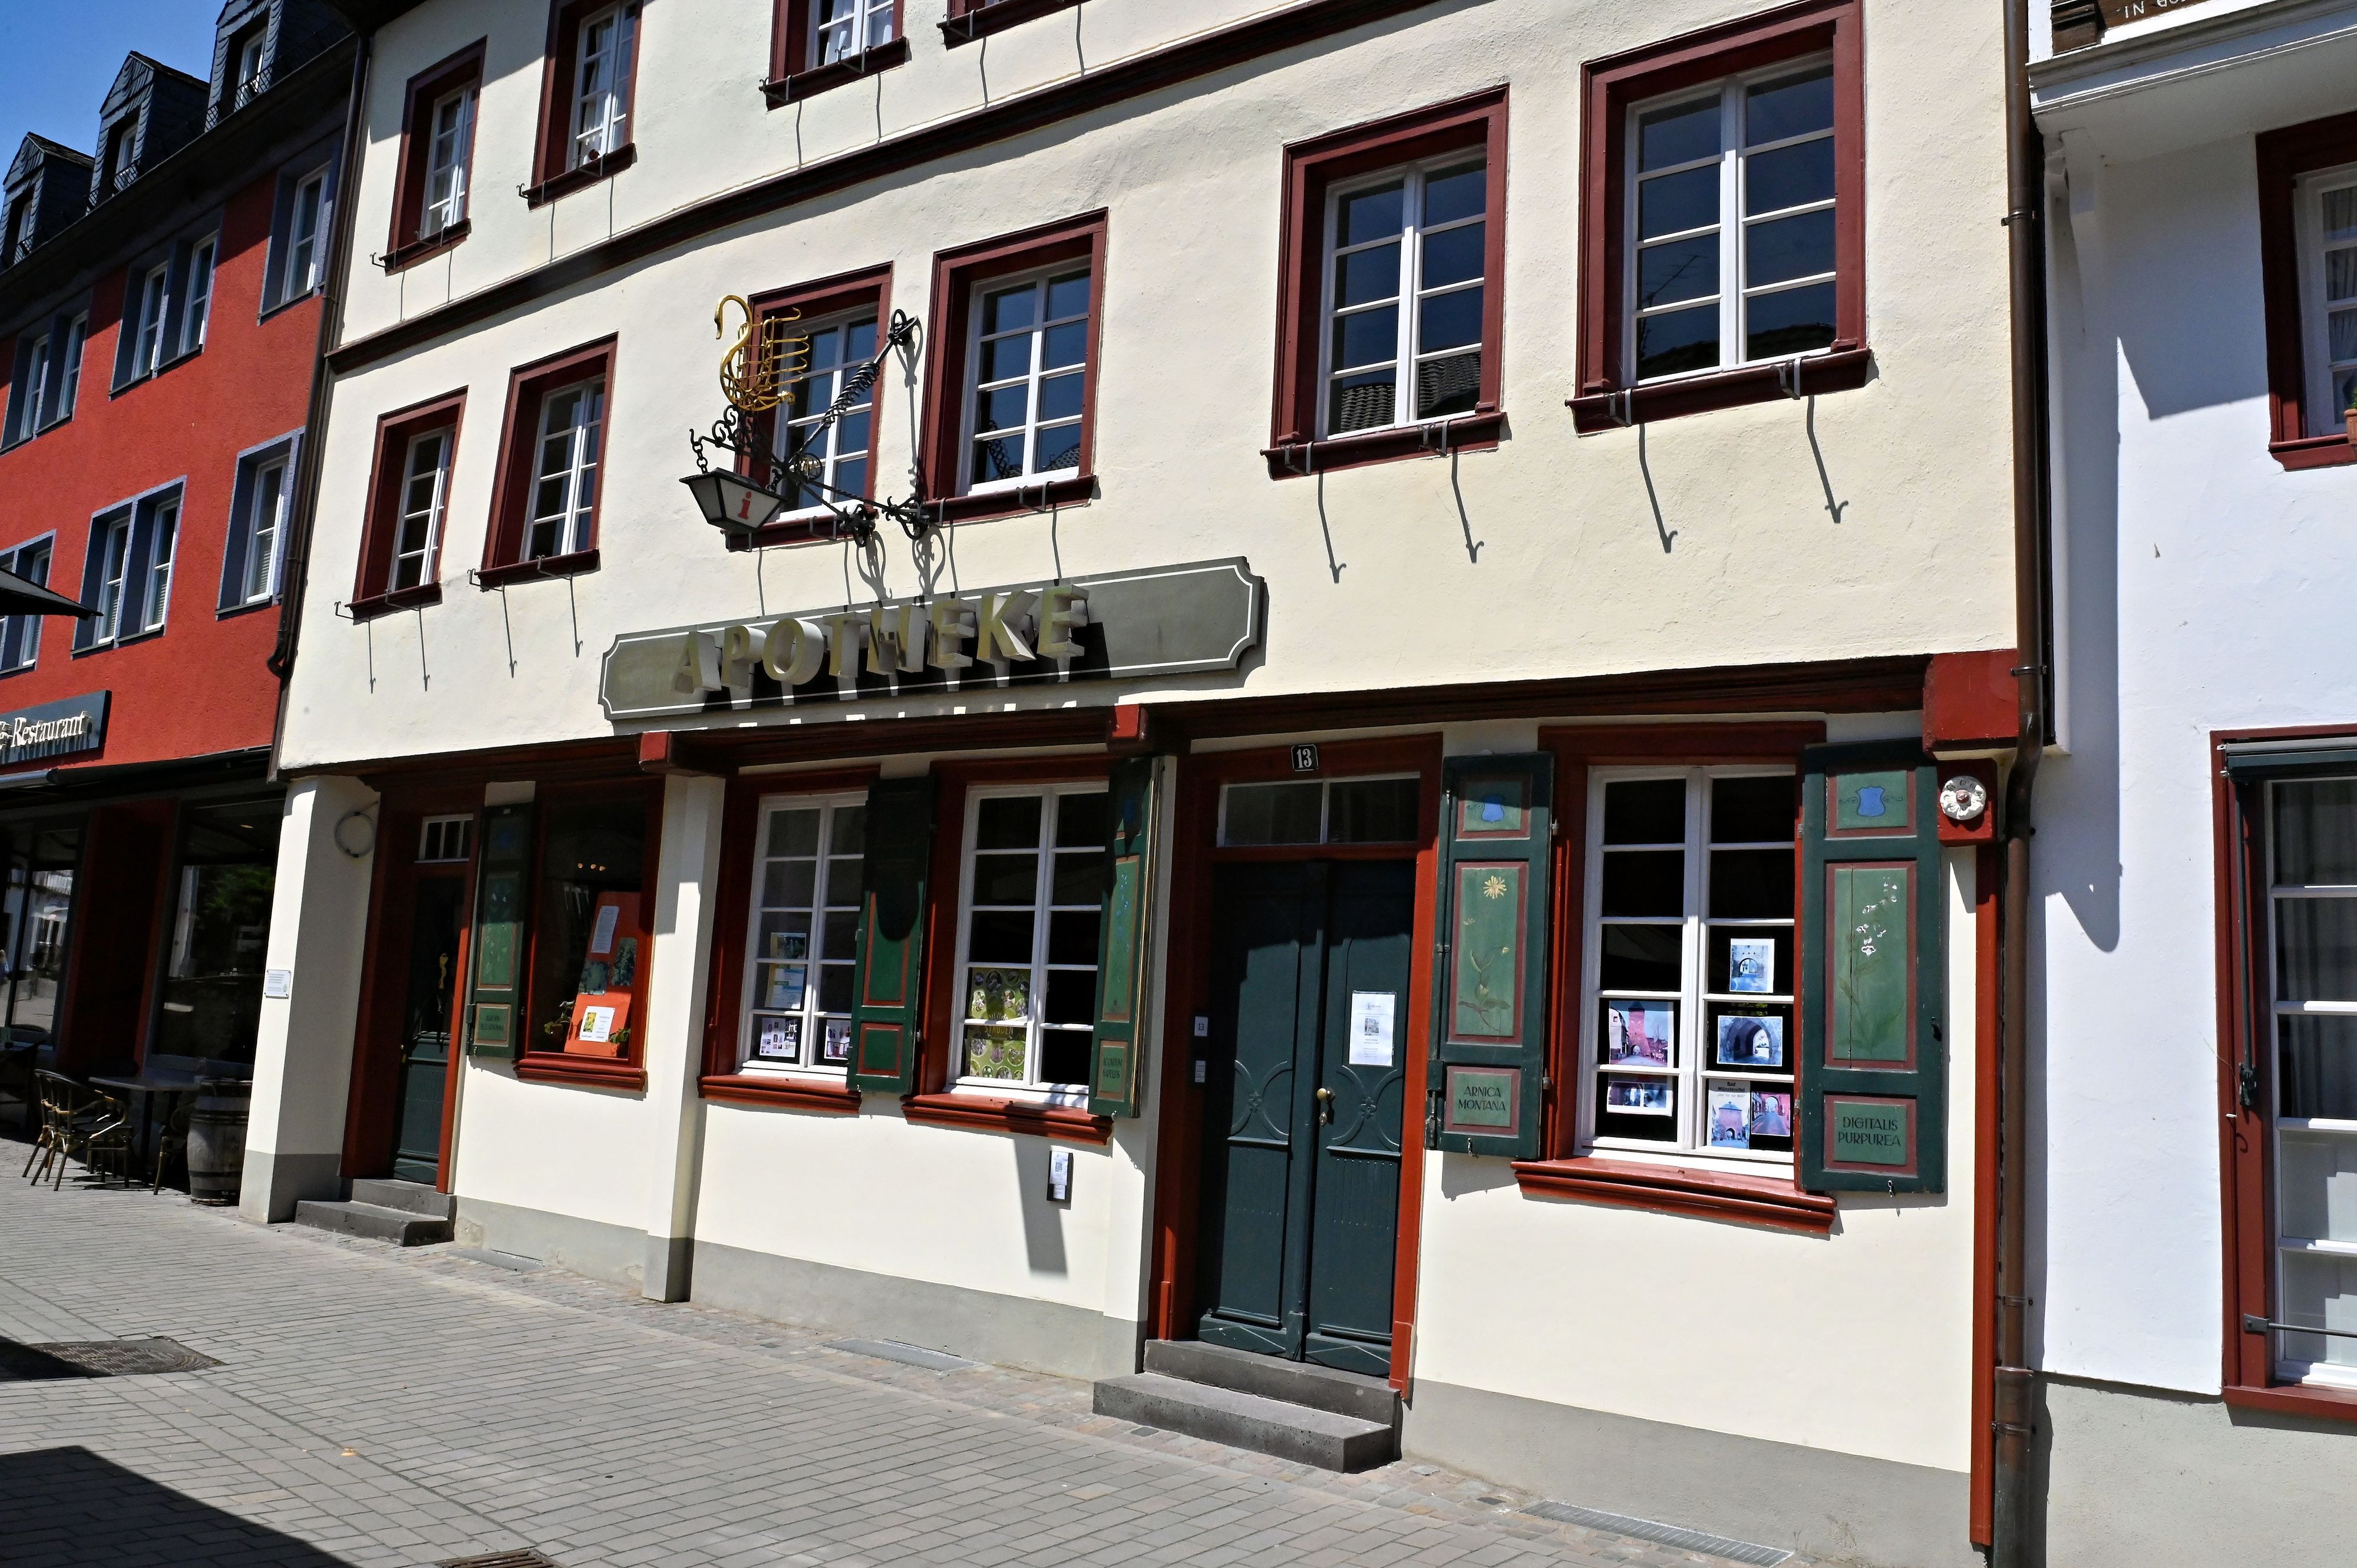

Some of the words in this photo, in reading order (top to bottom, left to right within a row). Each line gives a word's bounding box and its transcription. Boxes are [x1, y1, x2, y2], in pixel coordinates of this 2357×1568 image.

[2125, 1, 2144, 18] IN
[670, 583, 1090, 694] APOTHEKE
[1296, 748, 1312, 768] 13
[1464, 1085, 1501, 1098] ARNICA
[1458, 1098, 1506, 1111] MONTANA
[1843, 1117, 1899, 1131] DIGITALIS
[1838, 1131, 1902, 1147] PURPUREA
